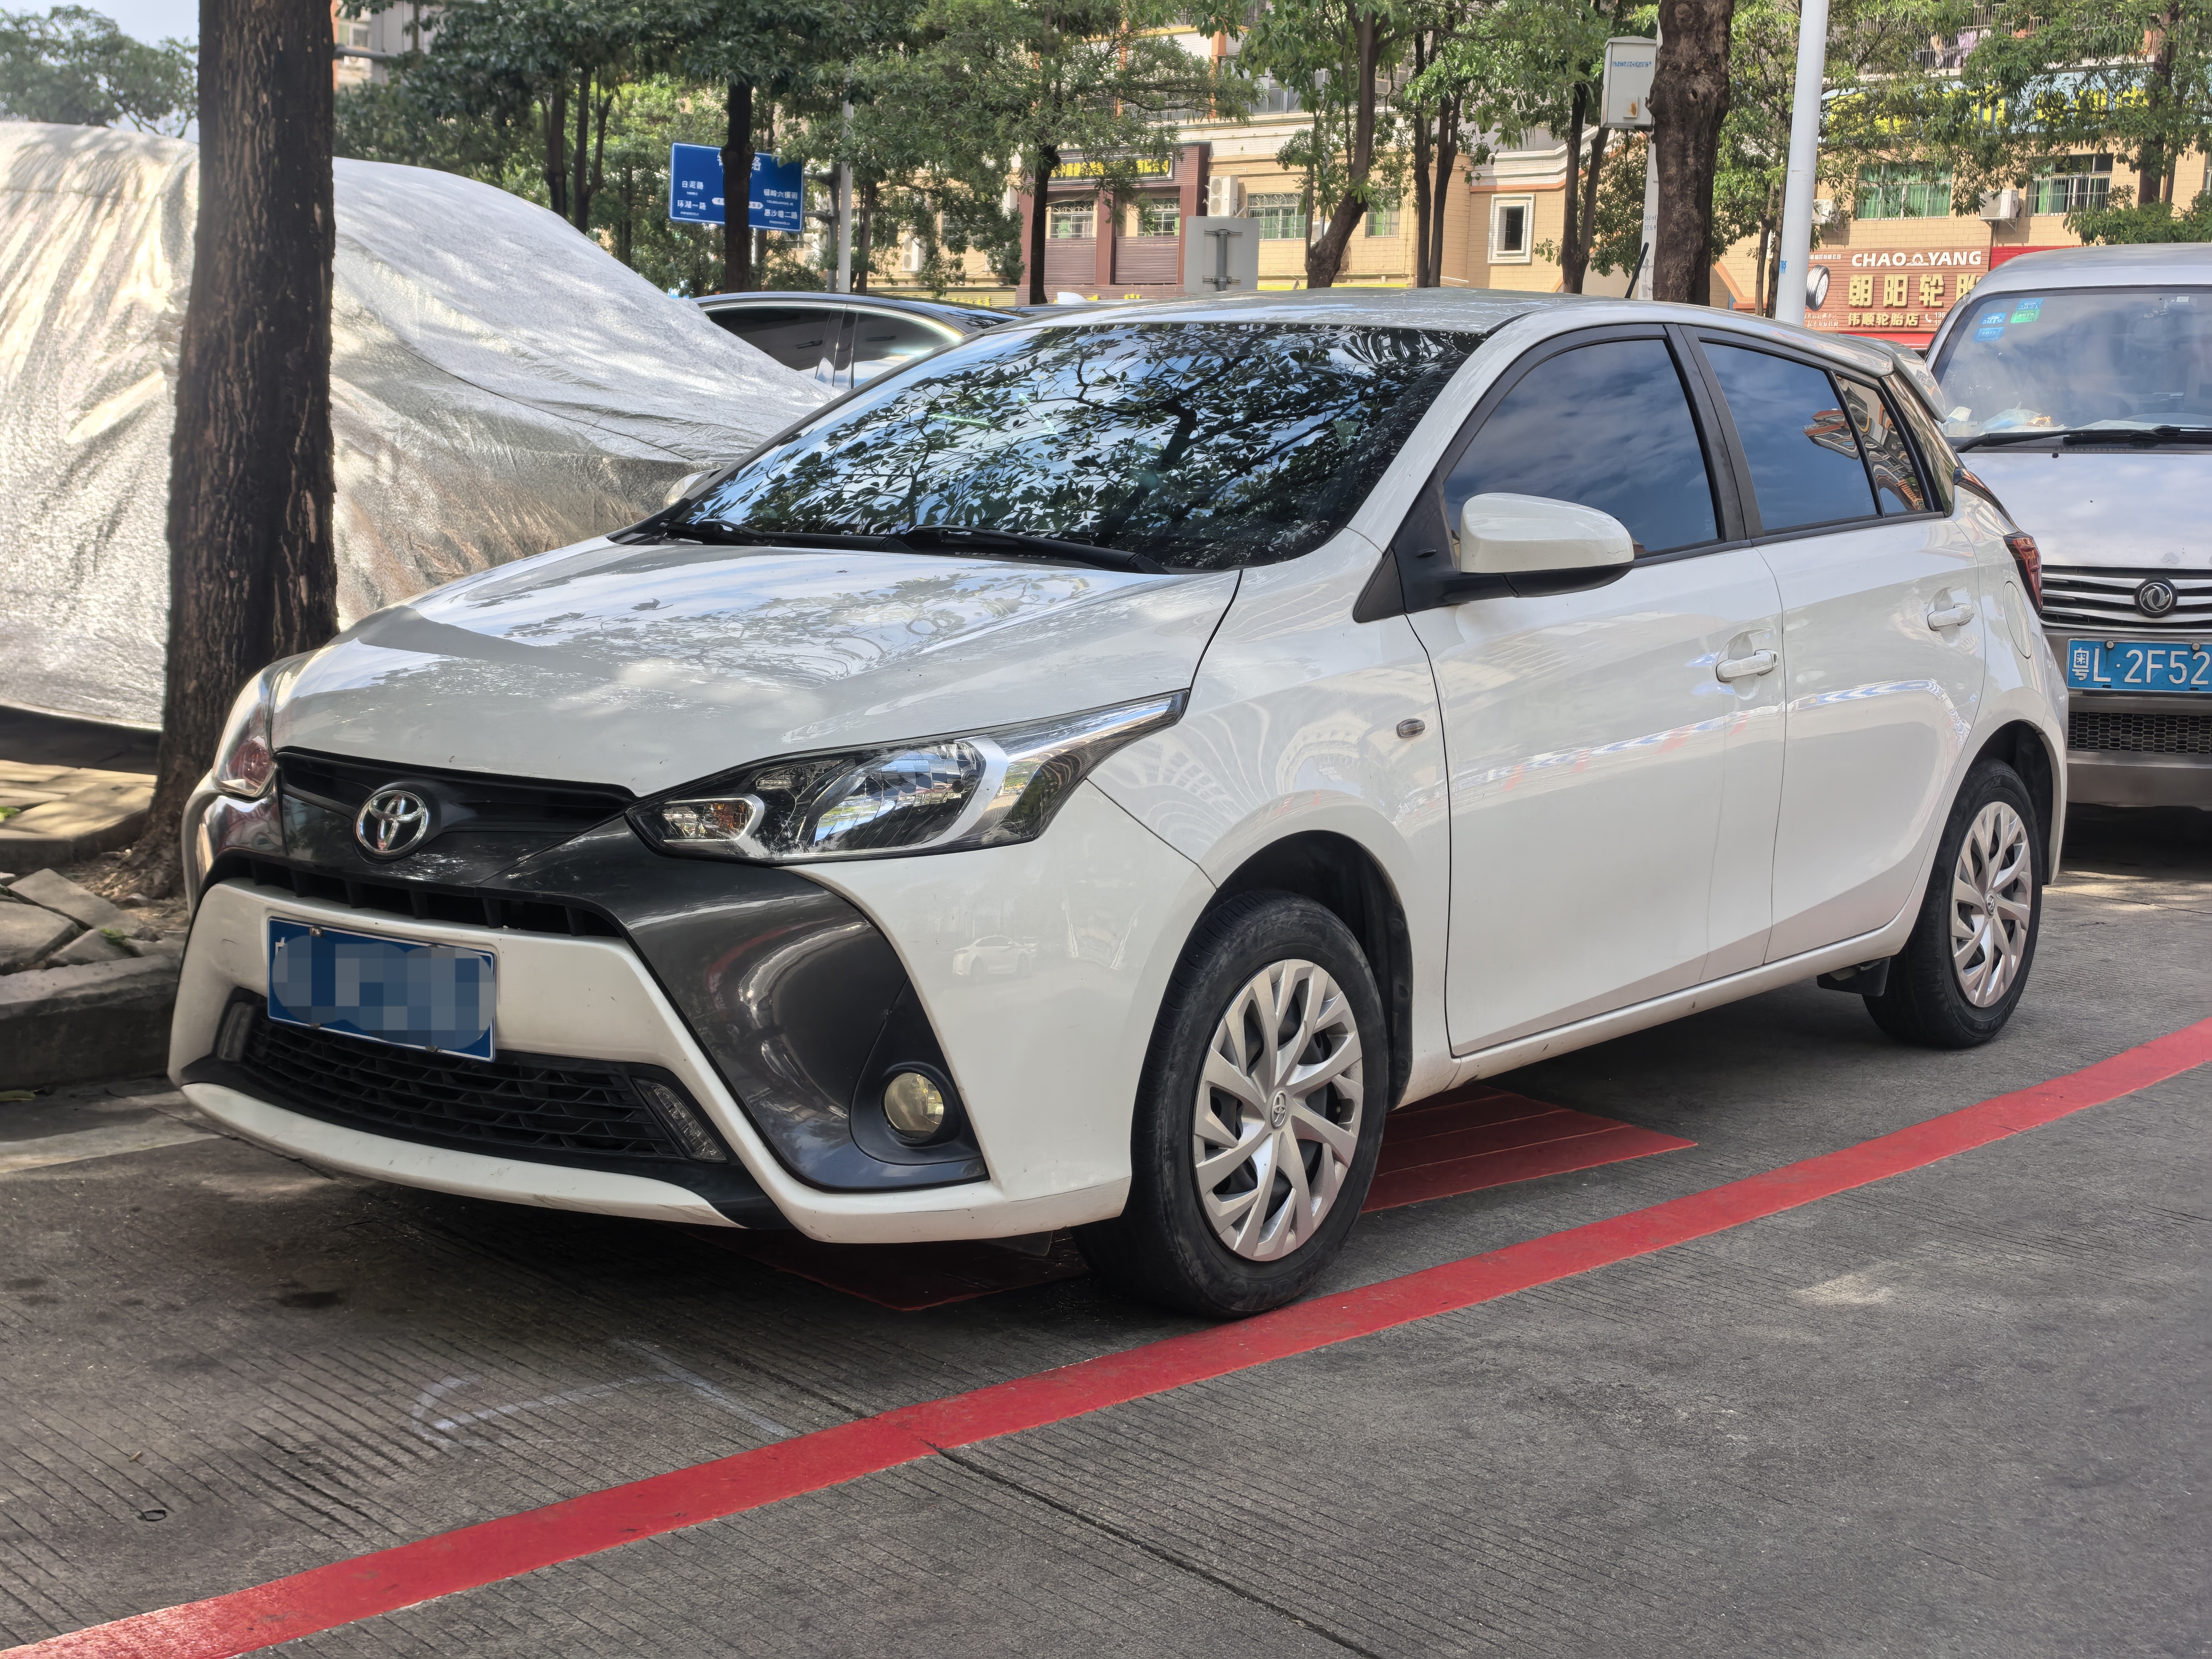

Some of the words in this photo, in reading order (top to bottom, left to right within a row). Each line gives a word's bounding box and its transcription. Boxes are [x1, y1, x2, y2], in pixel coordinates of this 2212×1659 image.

[1851, 252, 1907, 267] CHAO
[1928, 250, 1981, 266] YANG
[1847, 312, 1920, 328] 伟顺轮胎店
